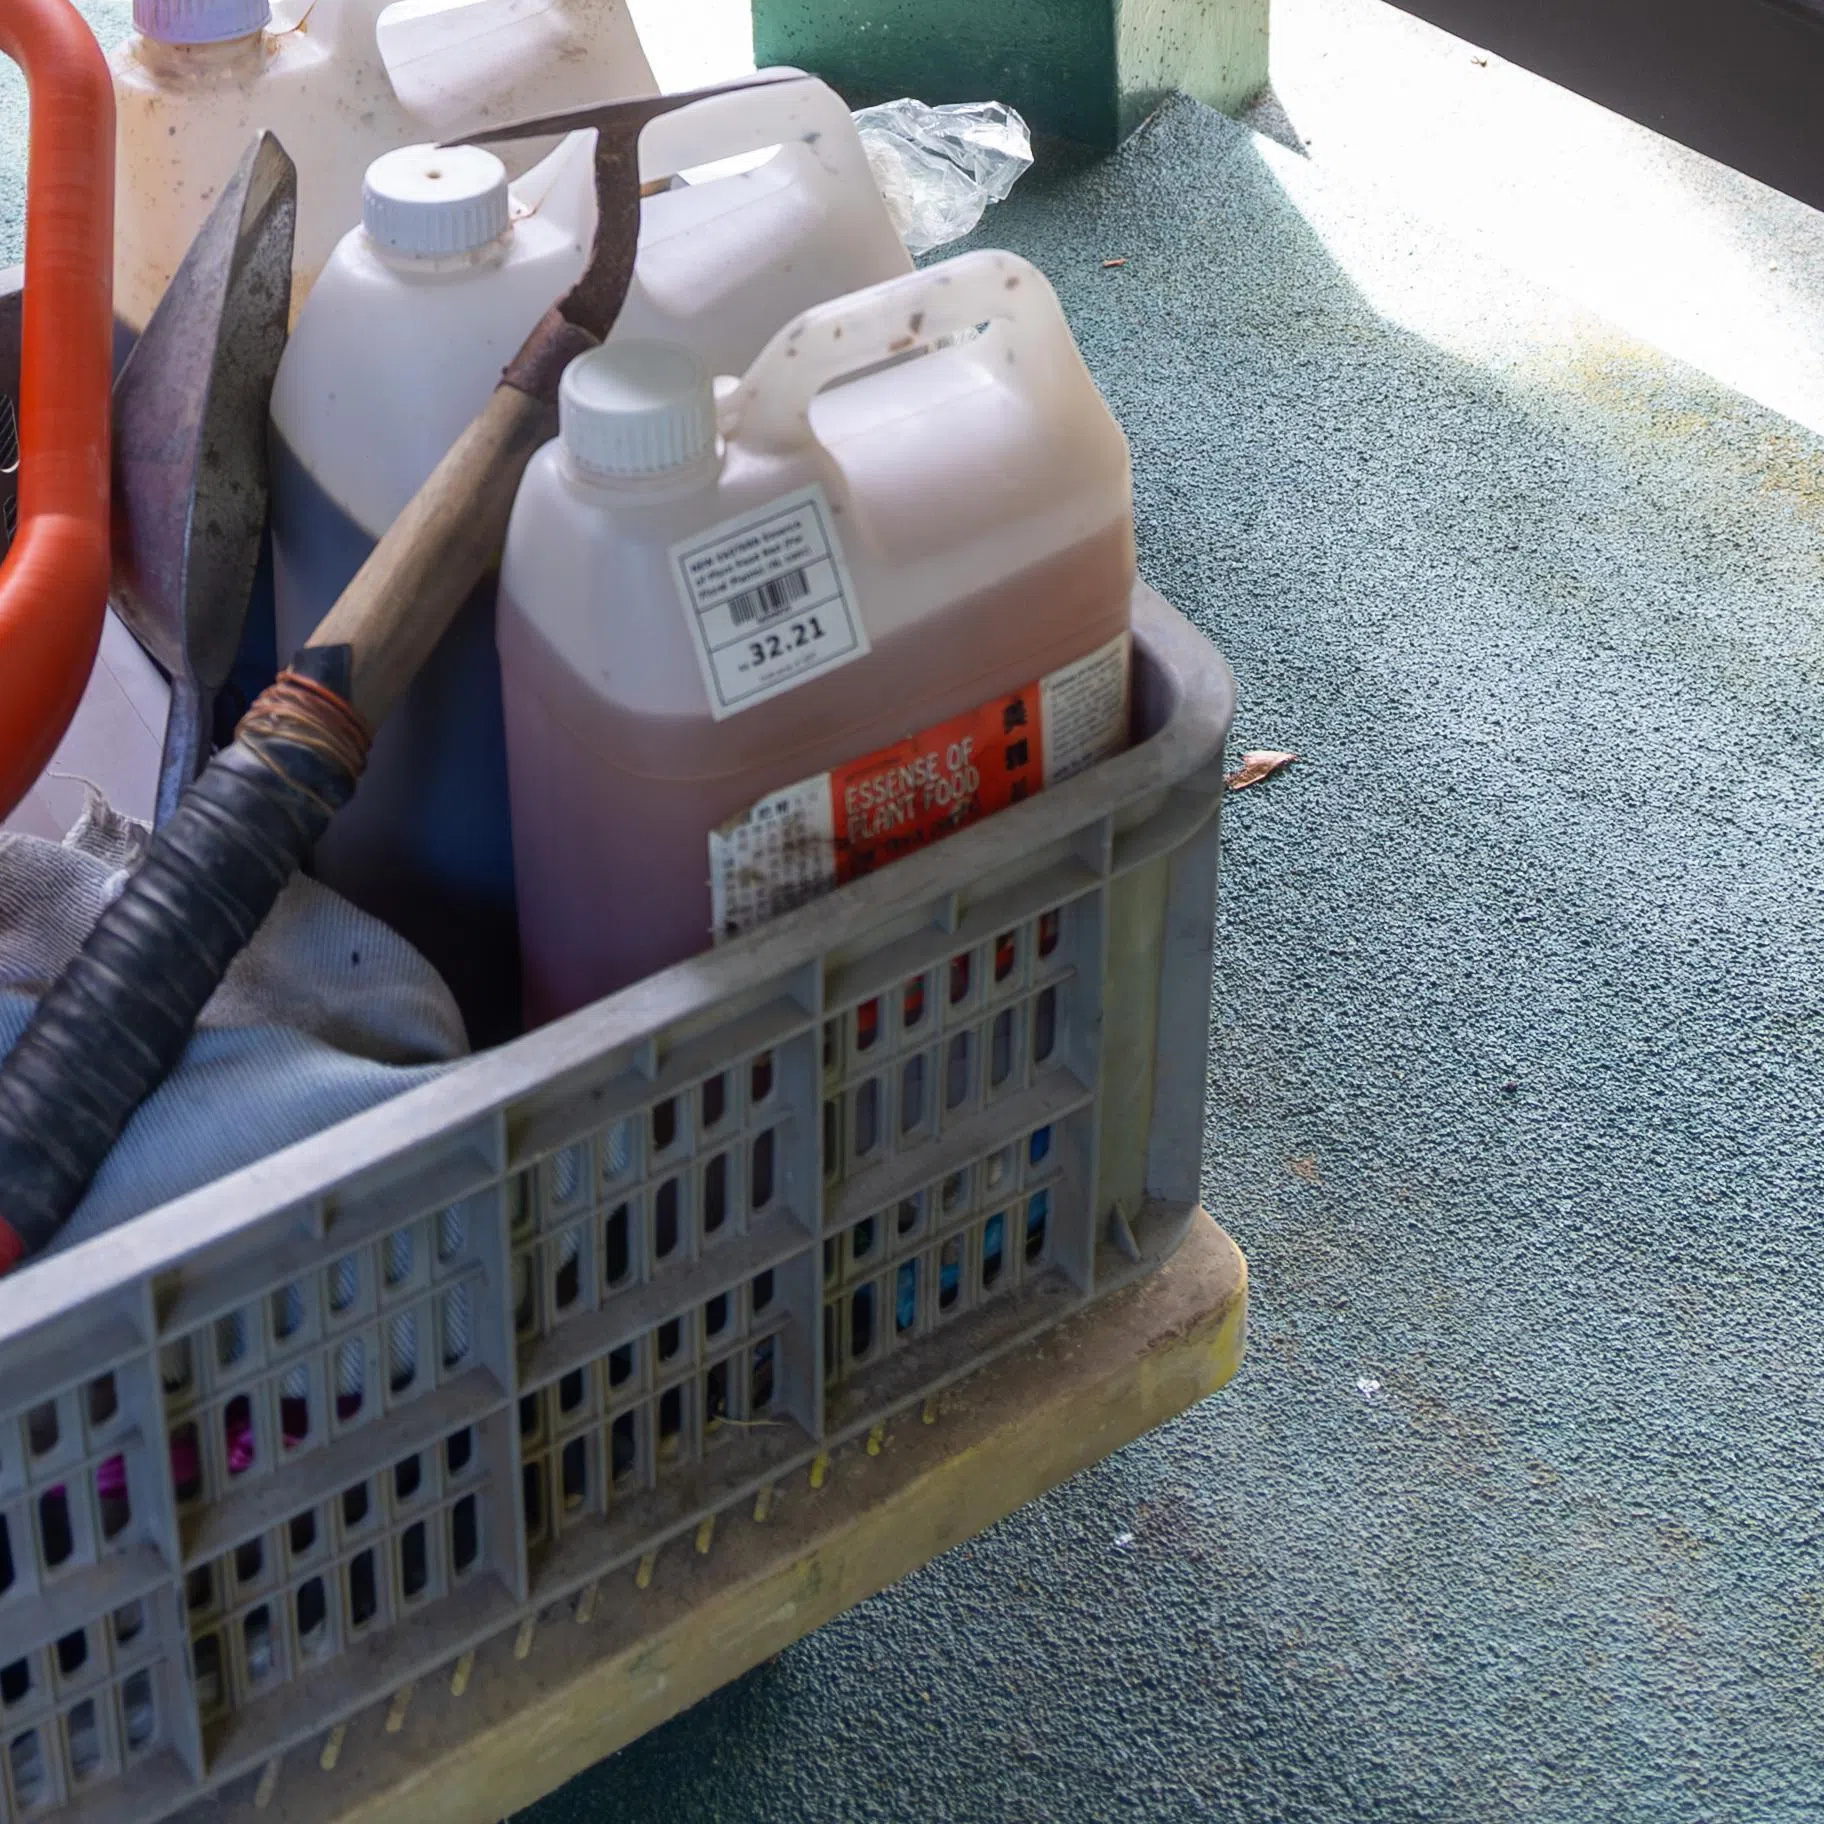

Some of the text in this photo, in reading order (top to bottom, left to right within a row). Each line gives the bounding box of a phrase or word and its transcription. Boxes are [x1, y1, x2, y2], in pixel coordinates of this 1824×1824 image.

[748, 616, 827, 668] 32.21
[844, 751, 941, 815] ESSENSE
[945, 736, 974, 772] OF
[923, 766, 980, 811] FOOD
